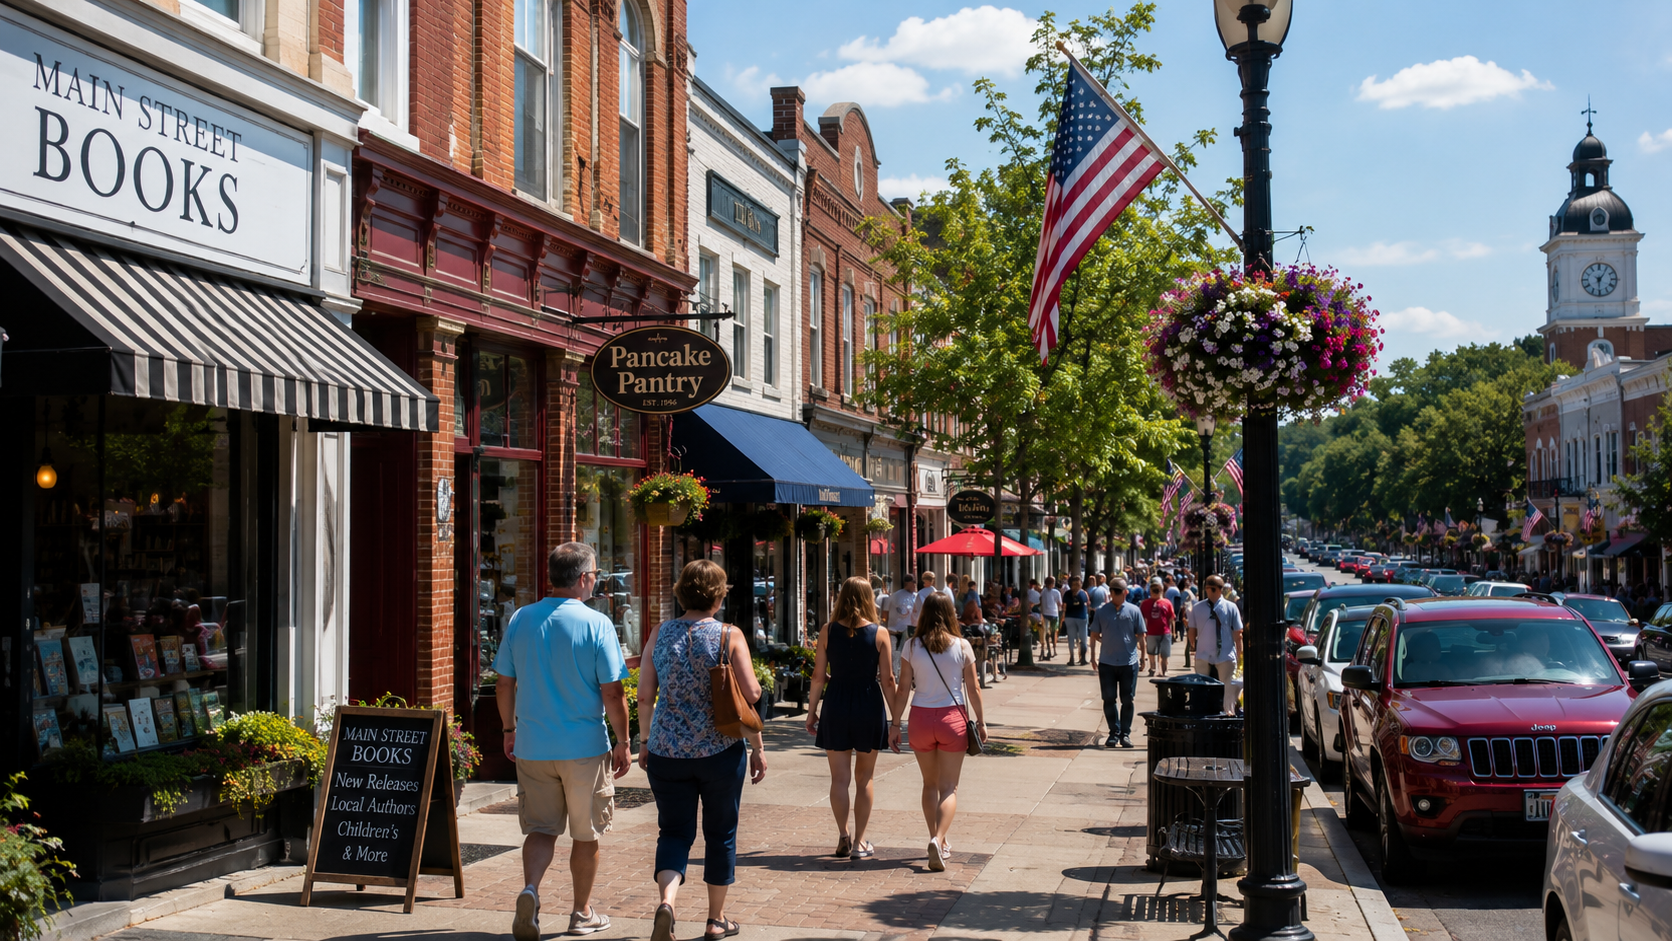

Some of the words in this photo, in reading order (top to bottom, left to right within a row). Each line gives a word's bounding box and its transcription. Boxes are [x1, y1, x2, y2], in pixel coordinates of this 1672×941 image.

[33, 52, 125, 120] MAIN
[138, 95, 242, 163] STREET
[33, 105, 239, 235] BOOKS
[609, 343, 712, 368] Pancake
[617, 371, 704, 399] Pantry
[343, 726, 378, 741] MAIN
[381, 728, 428, 745] STREET
[1530, 723, 1557, 732] Jeep
[350, 744, 413, 765] BOOKS
[335, 772, 363, 789] New
[366, 773, 420, 792] Releases
[331, 795, 365, 812] Local
[367, 797, 416, 815] Authors
[337, 820, 399, 840] Children's
[342, 845, 352, 861] &
[356, 845, 388, 862] More
